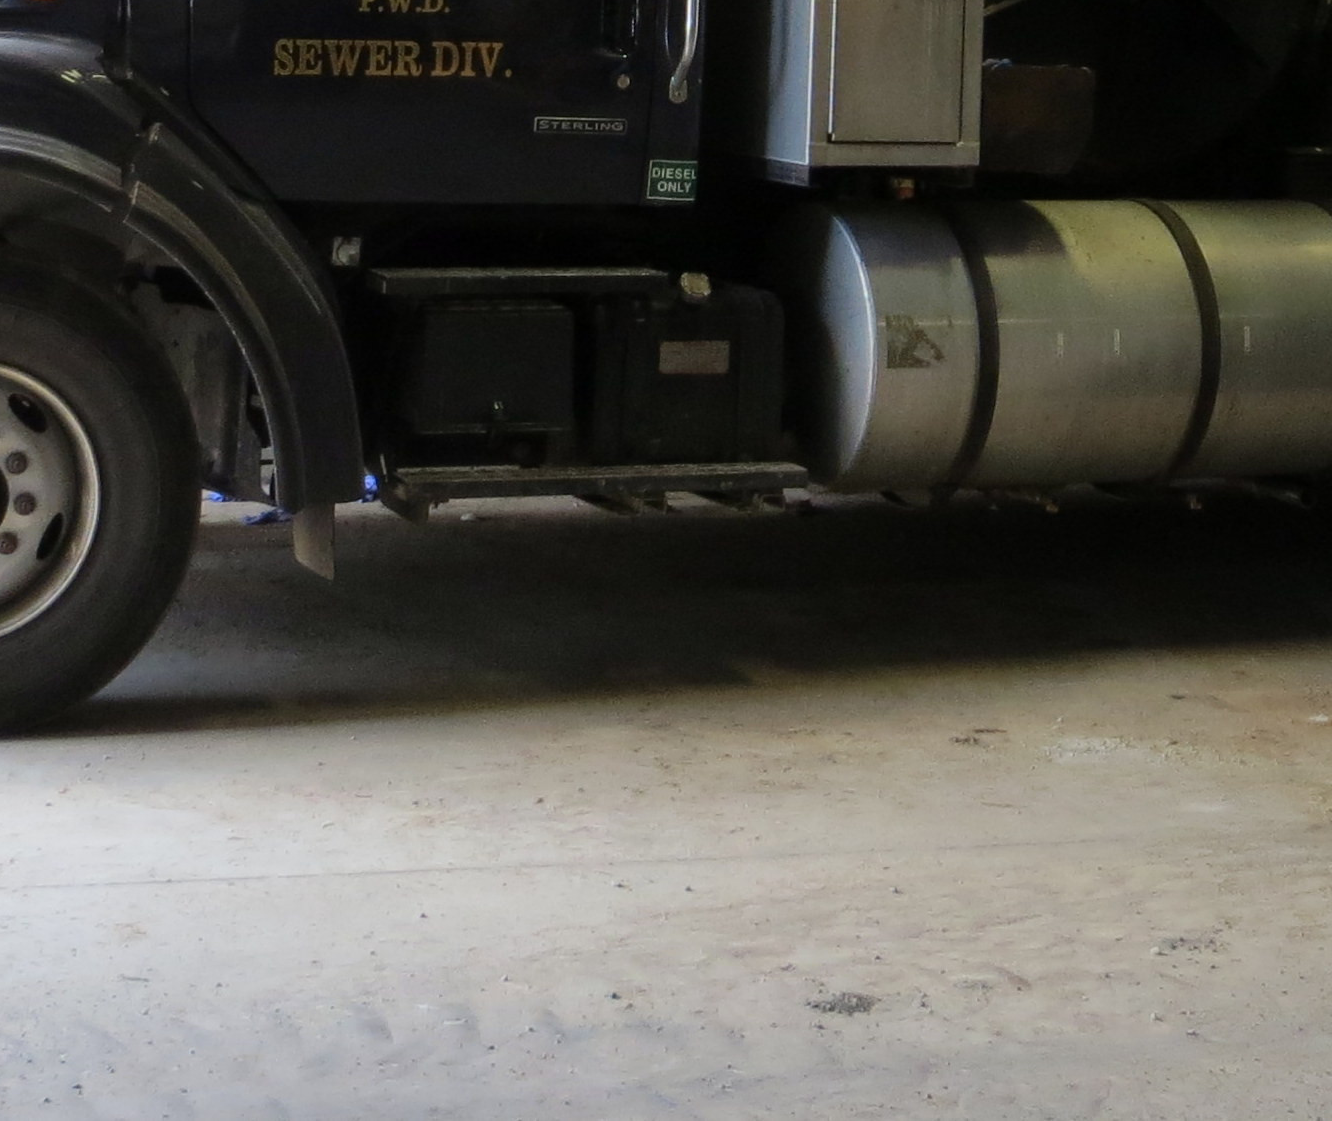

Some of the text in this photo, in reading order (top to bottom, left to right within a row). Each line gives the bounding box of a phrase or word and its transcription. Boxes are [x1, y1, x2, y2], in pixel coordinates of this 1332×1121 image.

[273, 38, 513, 78] SEWER DIV.
[538, 119, 625, 132] STERLING
[652, 167, 697, 180] DIESEL
[657, 181, 692, 194] ONLY
